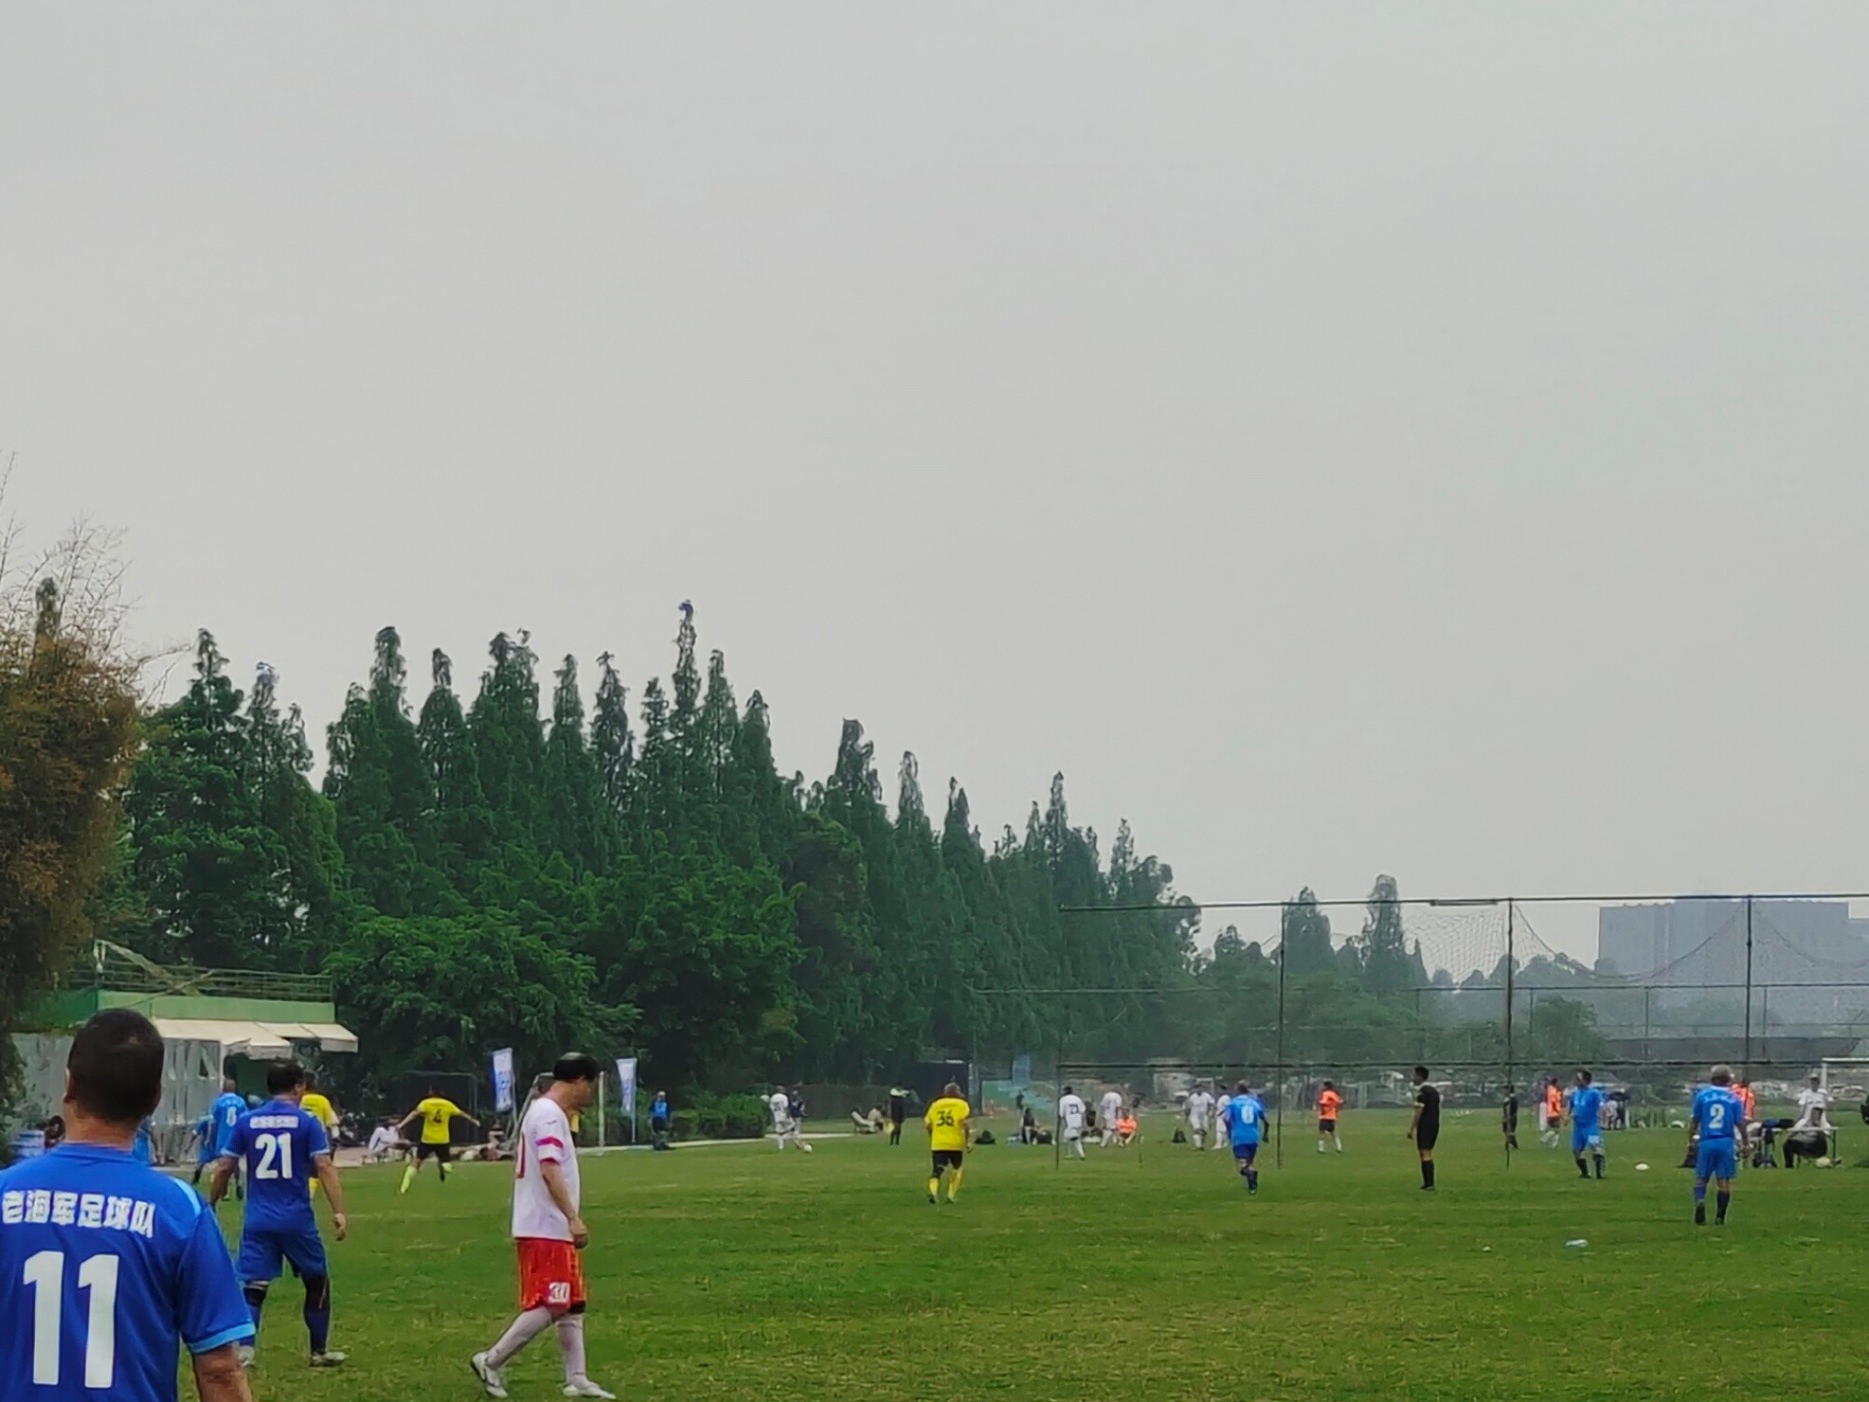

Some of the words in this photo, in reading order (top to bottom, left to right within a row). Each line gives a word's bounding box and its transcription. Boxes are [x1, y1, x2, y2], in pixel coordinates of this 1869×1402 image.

[1709, 1104, 1725, 1129] 2
[255, 1132, 292, 1179] 21
[23, 1250, 119, 1389] 11
